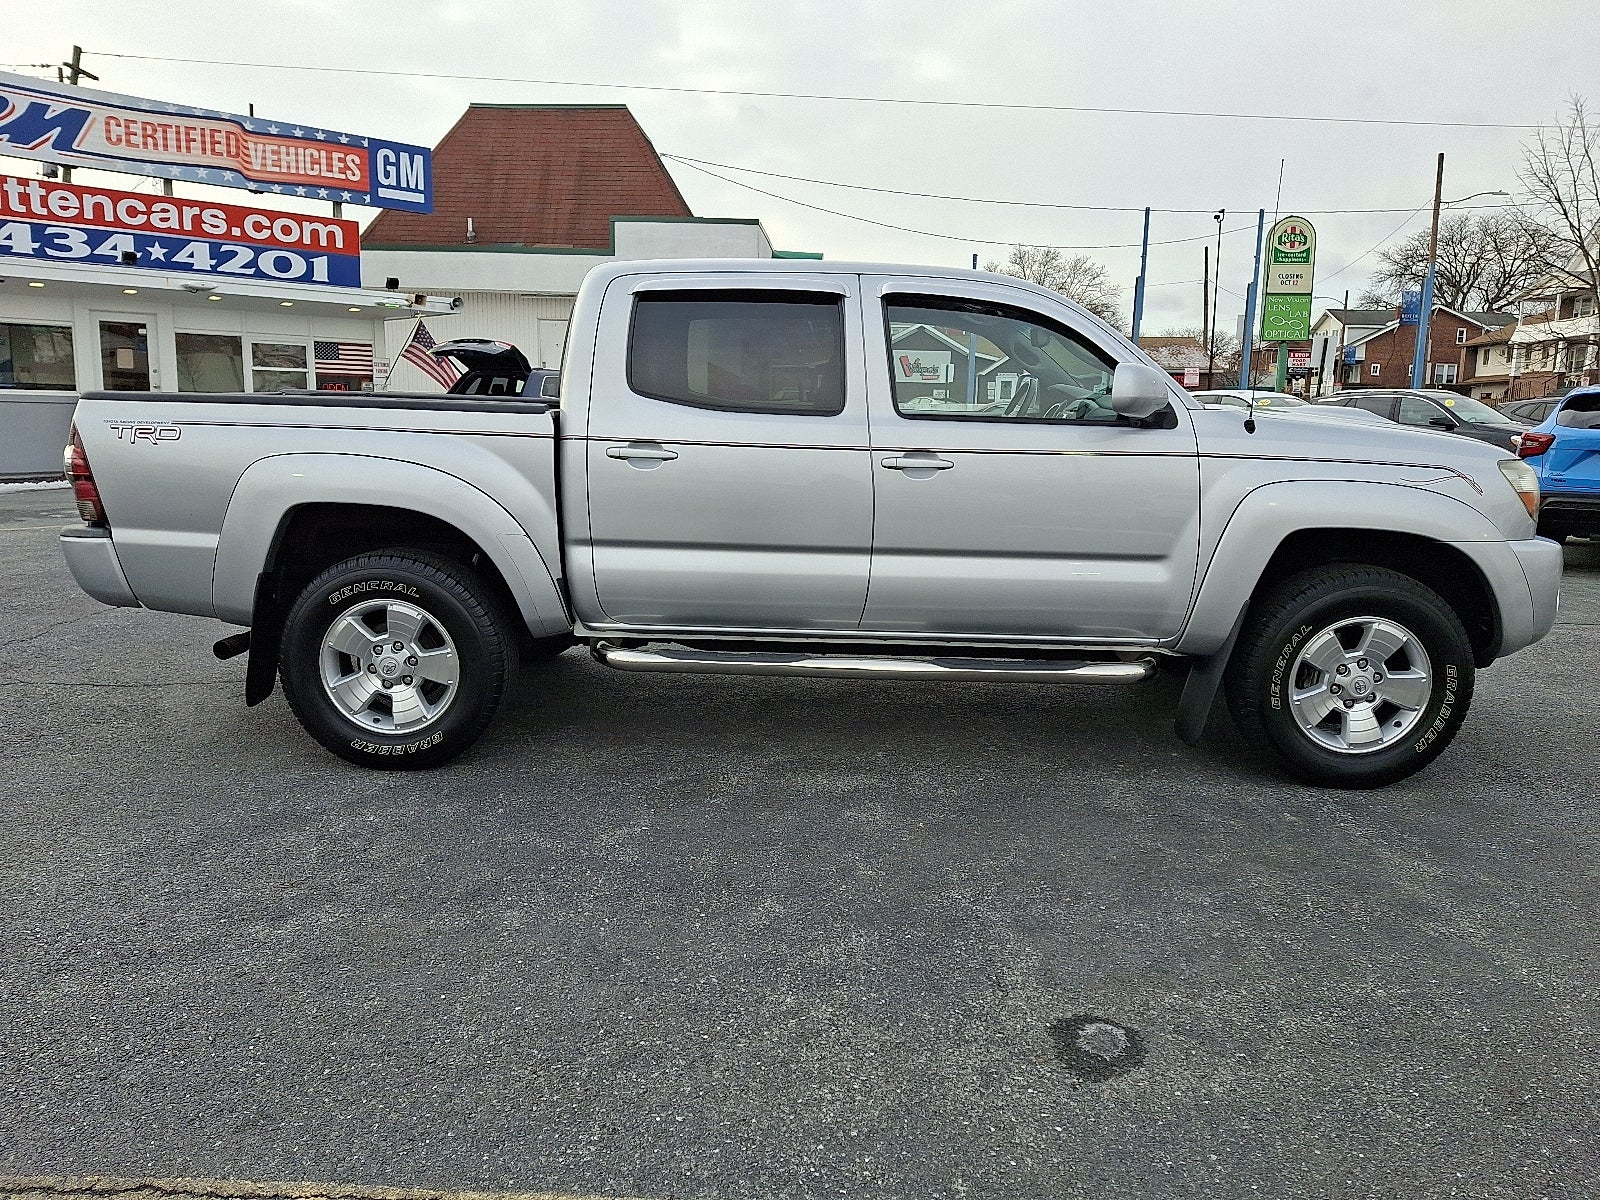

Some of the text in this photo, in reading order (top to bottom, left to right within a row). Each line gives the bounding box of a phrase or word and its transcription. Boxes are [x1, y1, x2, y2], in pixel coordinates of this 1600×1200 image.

[104, 115, 241, 159] CERTIFIED
[248, 141, 362, 182] VEHICLES
[376, 148, 425, 191] GM
[0, 177, 343, 249] ttencars.com
[1281, 232, 1305, 243] Rita's
[1289, 310, 1308, 318] LAB
[1265, 330, 1306, 339] OPTICAL
[322, 383, 349, 391] OPEN
[109, 424, 182, 445] TRD
[328, 580, 419, 605] GENERAL
[1270, 624, 1313, 710] GENERAL
[1414, 664, 1458, 753] GRABBER
[350, 731, 443, 755] GRABBER
